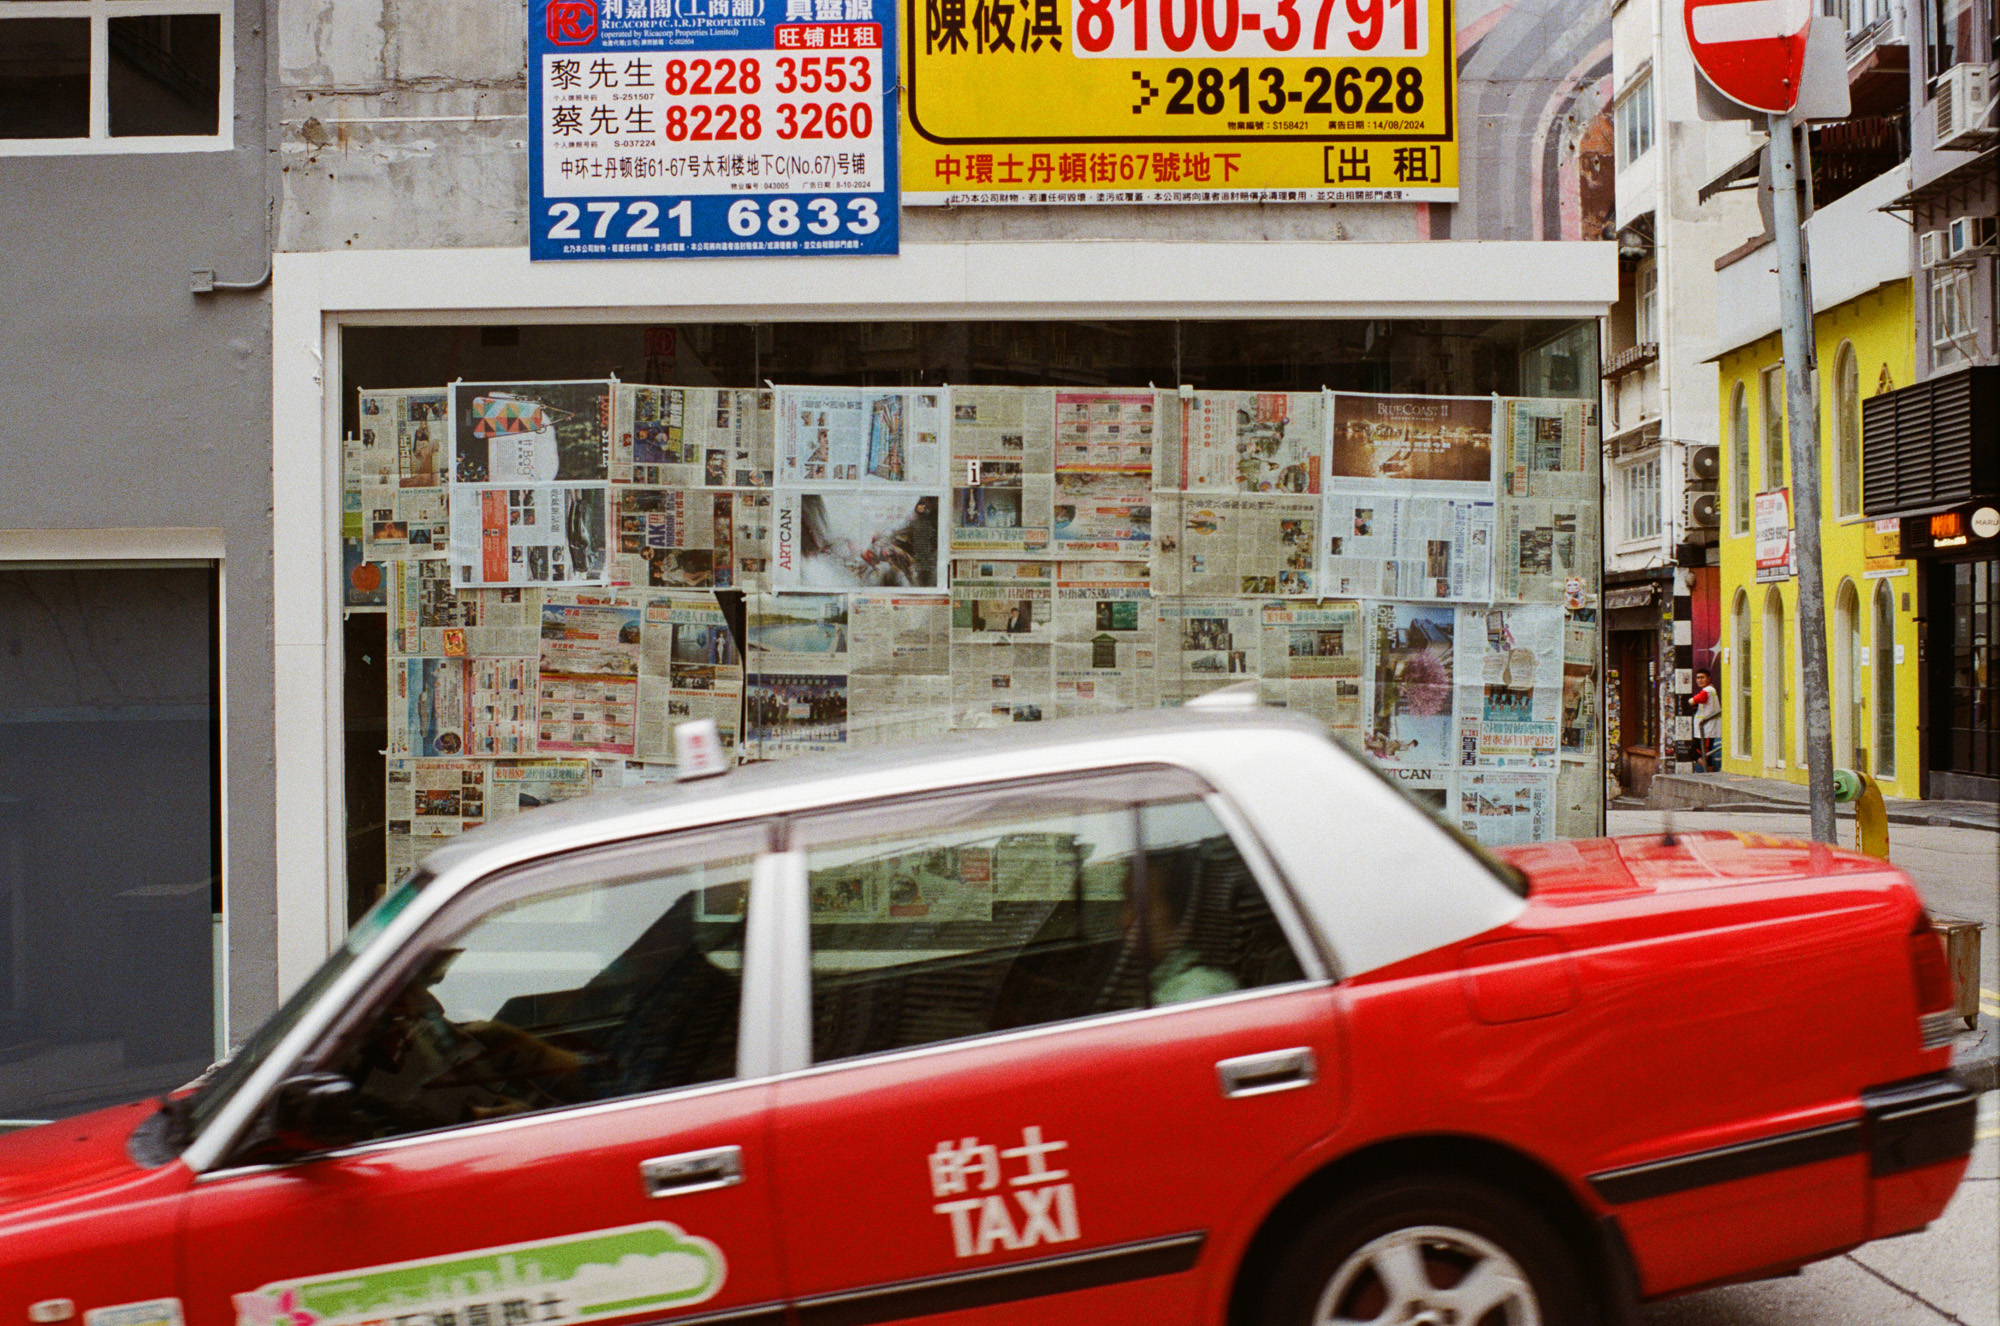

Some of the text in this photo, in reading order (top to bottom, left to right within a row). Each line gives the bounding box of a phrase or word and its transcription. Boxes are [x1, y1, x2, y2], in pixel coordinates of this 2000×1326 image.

[633, 30, 642, 39] by
[697, 17, 766, 27] PROPERTIES
[779, 27, 877, 47] 旺铺出租
[1076, 0, 1418, 52] 8100-3791
[550, 56, 872, 96] 黎先生 8228 3553
[1166, 66, 1425, 115] 2813-2628
[613, 93, 655, 101] S-251507
[552, 102, 873, 142] 蔡先生 8228 3260
[614, 140, 656, 148] S-037224
[935, 152, 1242, 185] 中環士丹頓街67號地下
[547, 197, 881, 239] 2721 6833
[971, 462, 978, 482] i
[779, 508, 792, 571] ARTCAN
[927, 1125, 1070, 1197] 的士
[932, 1182, 1082, 1259] TAXI
